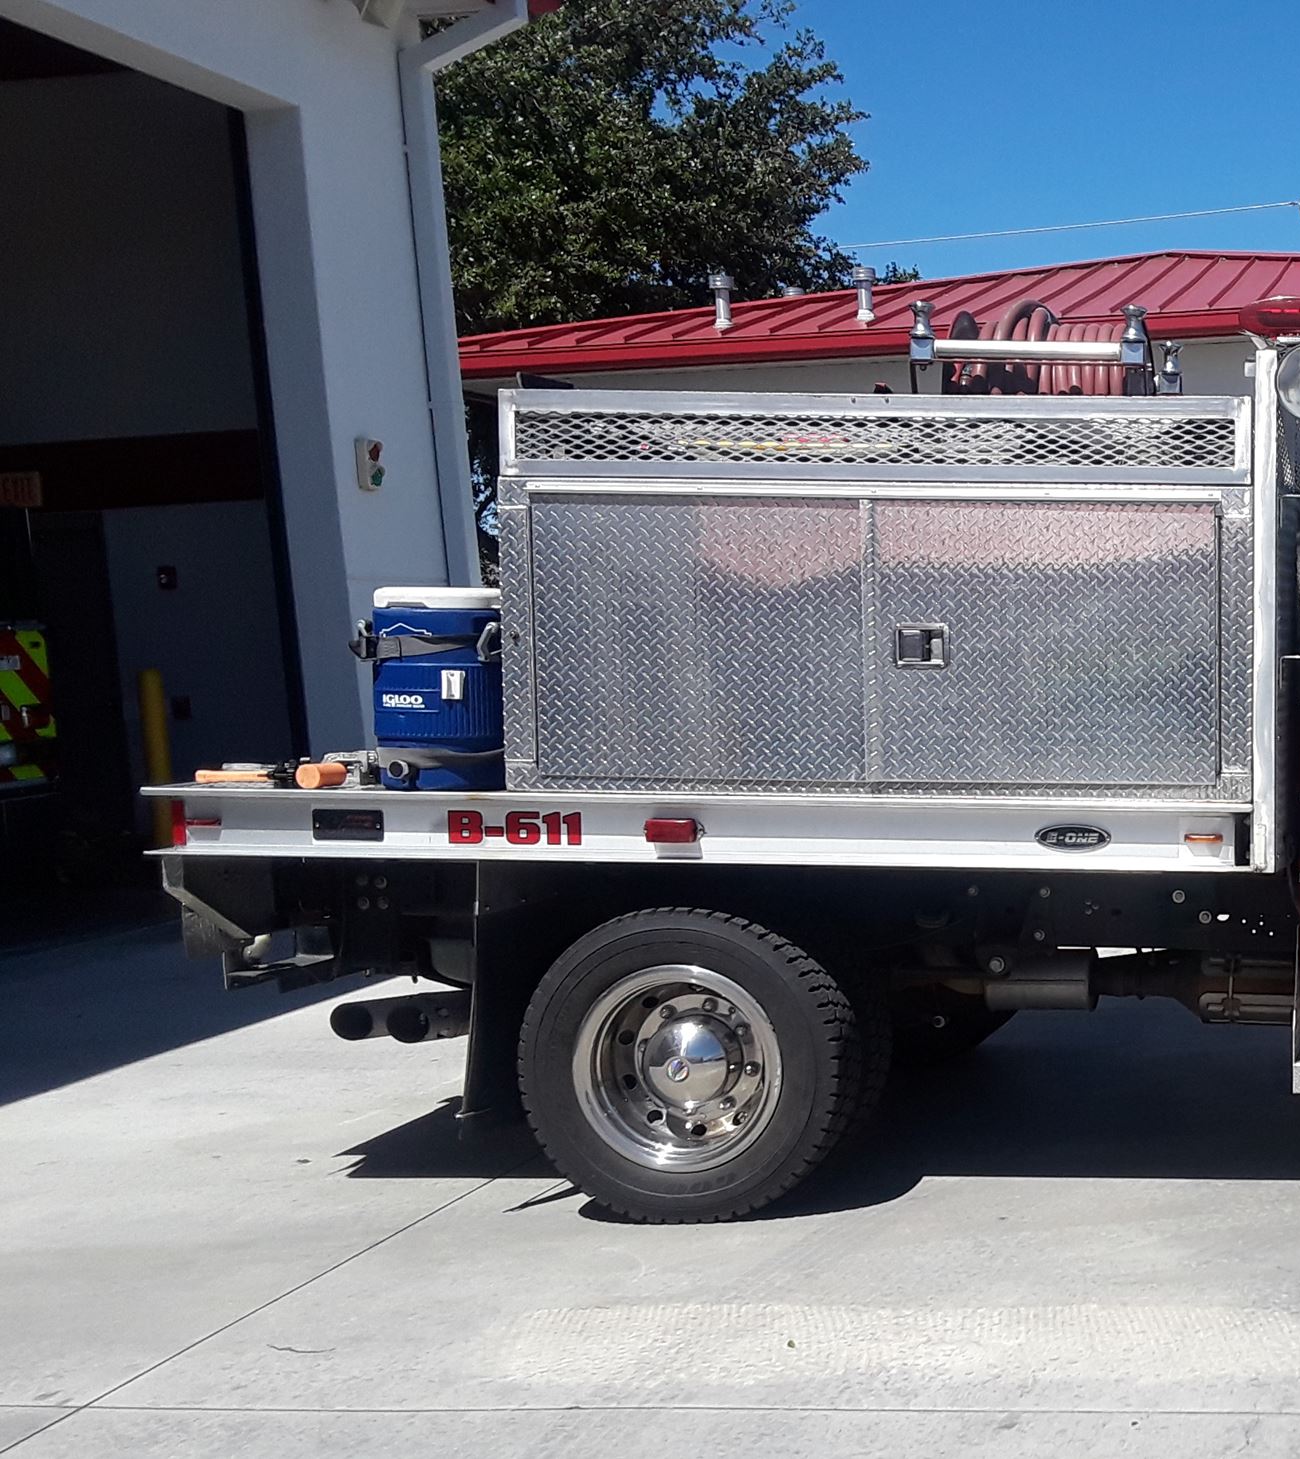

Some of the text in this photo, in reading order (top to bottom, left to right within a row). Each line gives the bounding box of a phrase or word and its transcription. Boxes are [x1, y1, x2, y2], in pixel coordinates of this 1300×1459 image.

[382, 693, 423, 707] IGLOO
[447, 810, 582, 845] B-611
[1046, 832, 1100, 843] E-ONE
